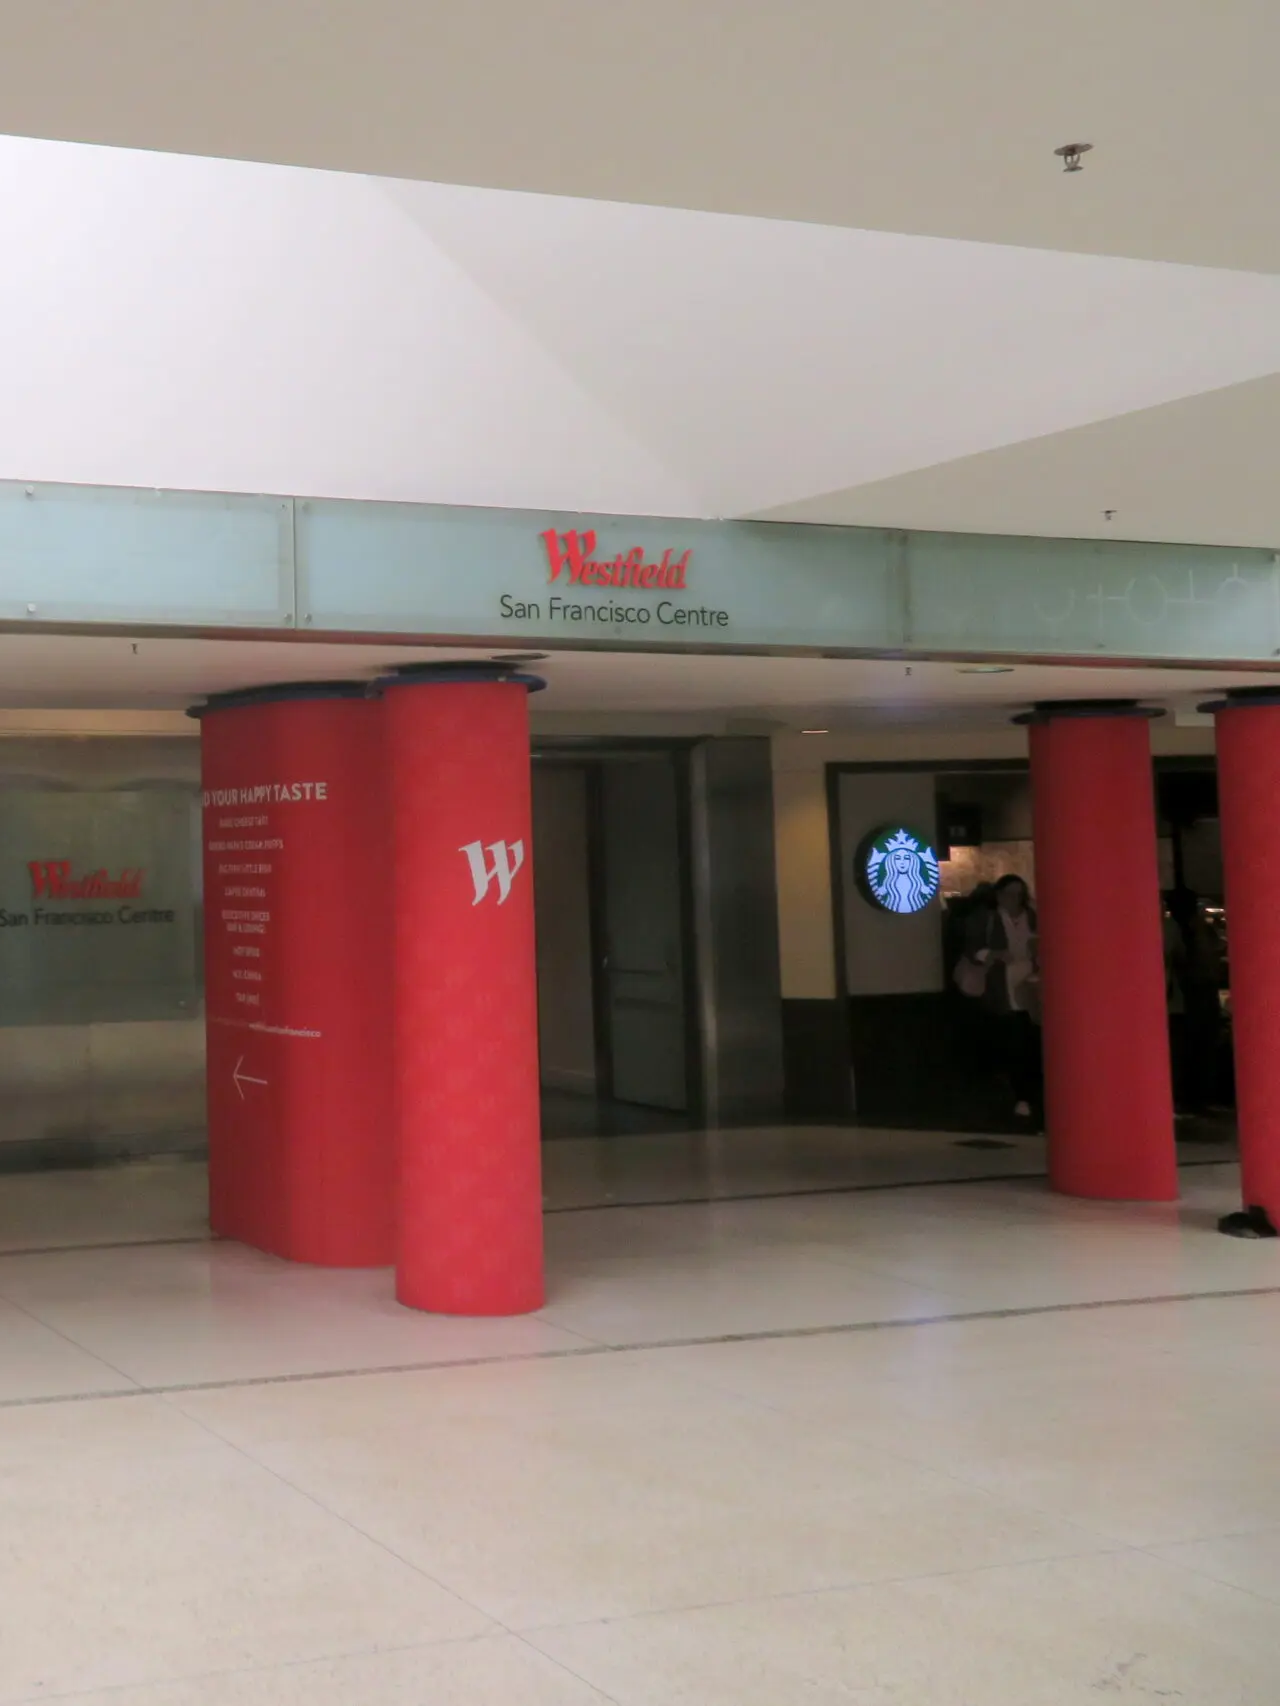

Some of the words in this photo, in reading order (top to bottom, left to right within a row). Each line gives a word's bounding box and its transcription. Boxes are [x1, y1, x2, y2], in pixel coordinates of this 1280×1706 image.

[538, 528, 693, 589] Westfield
[499, 594, 540, 620] San
[549, 597, 651, 624] Francisco
[656, 601, 729, 627] Centre
[211, 788, 238, 807] YOUR
[240, 785, 270, 805] HAPPY
[273, 781, 328, 802] TASTE
[27, 860, 144, 899] Westfield
[34, 907, 114, 927] Francisco
[119, 904, 176, 925] Centre
